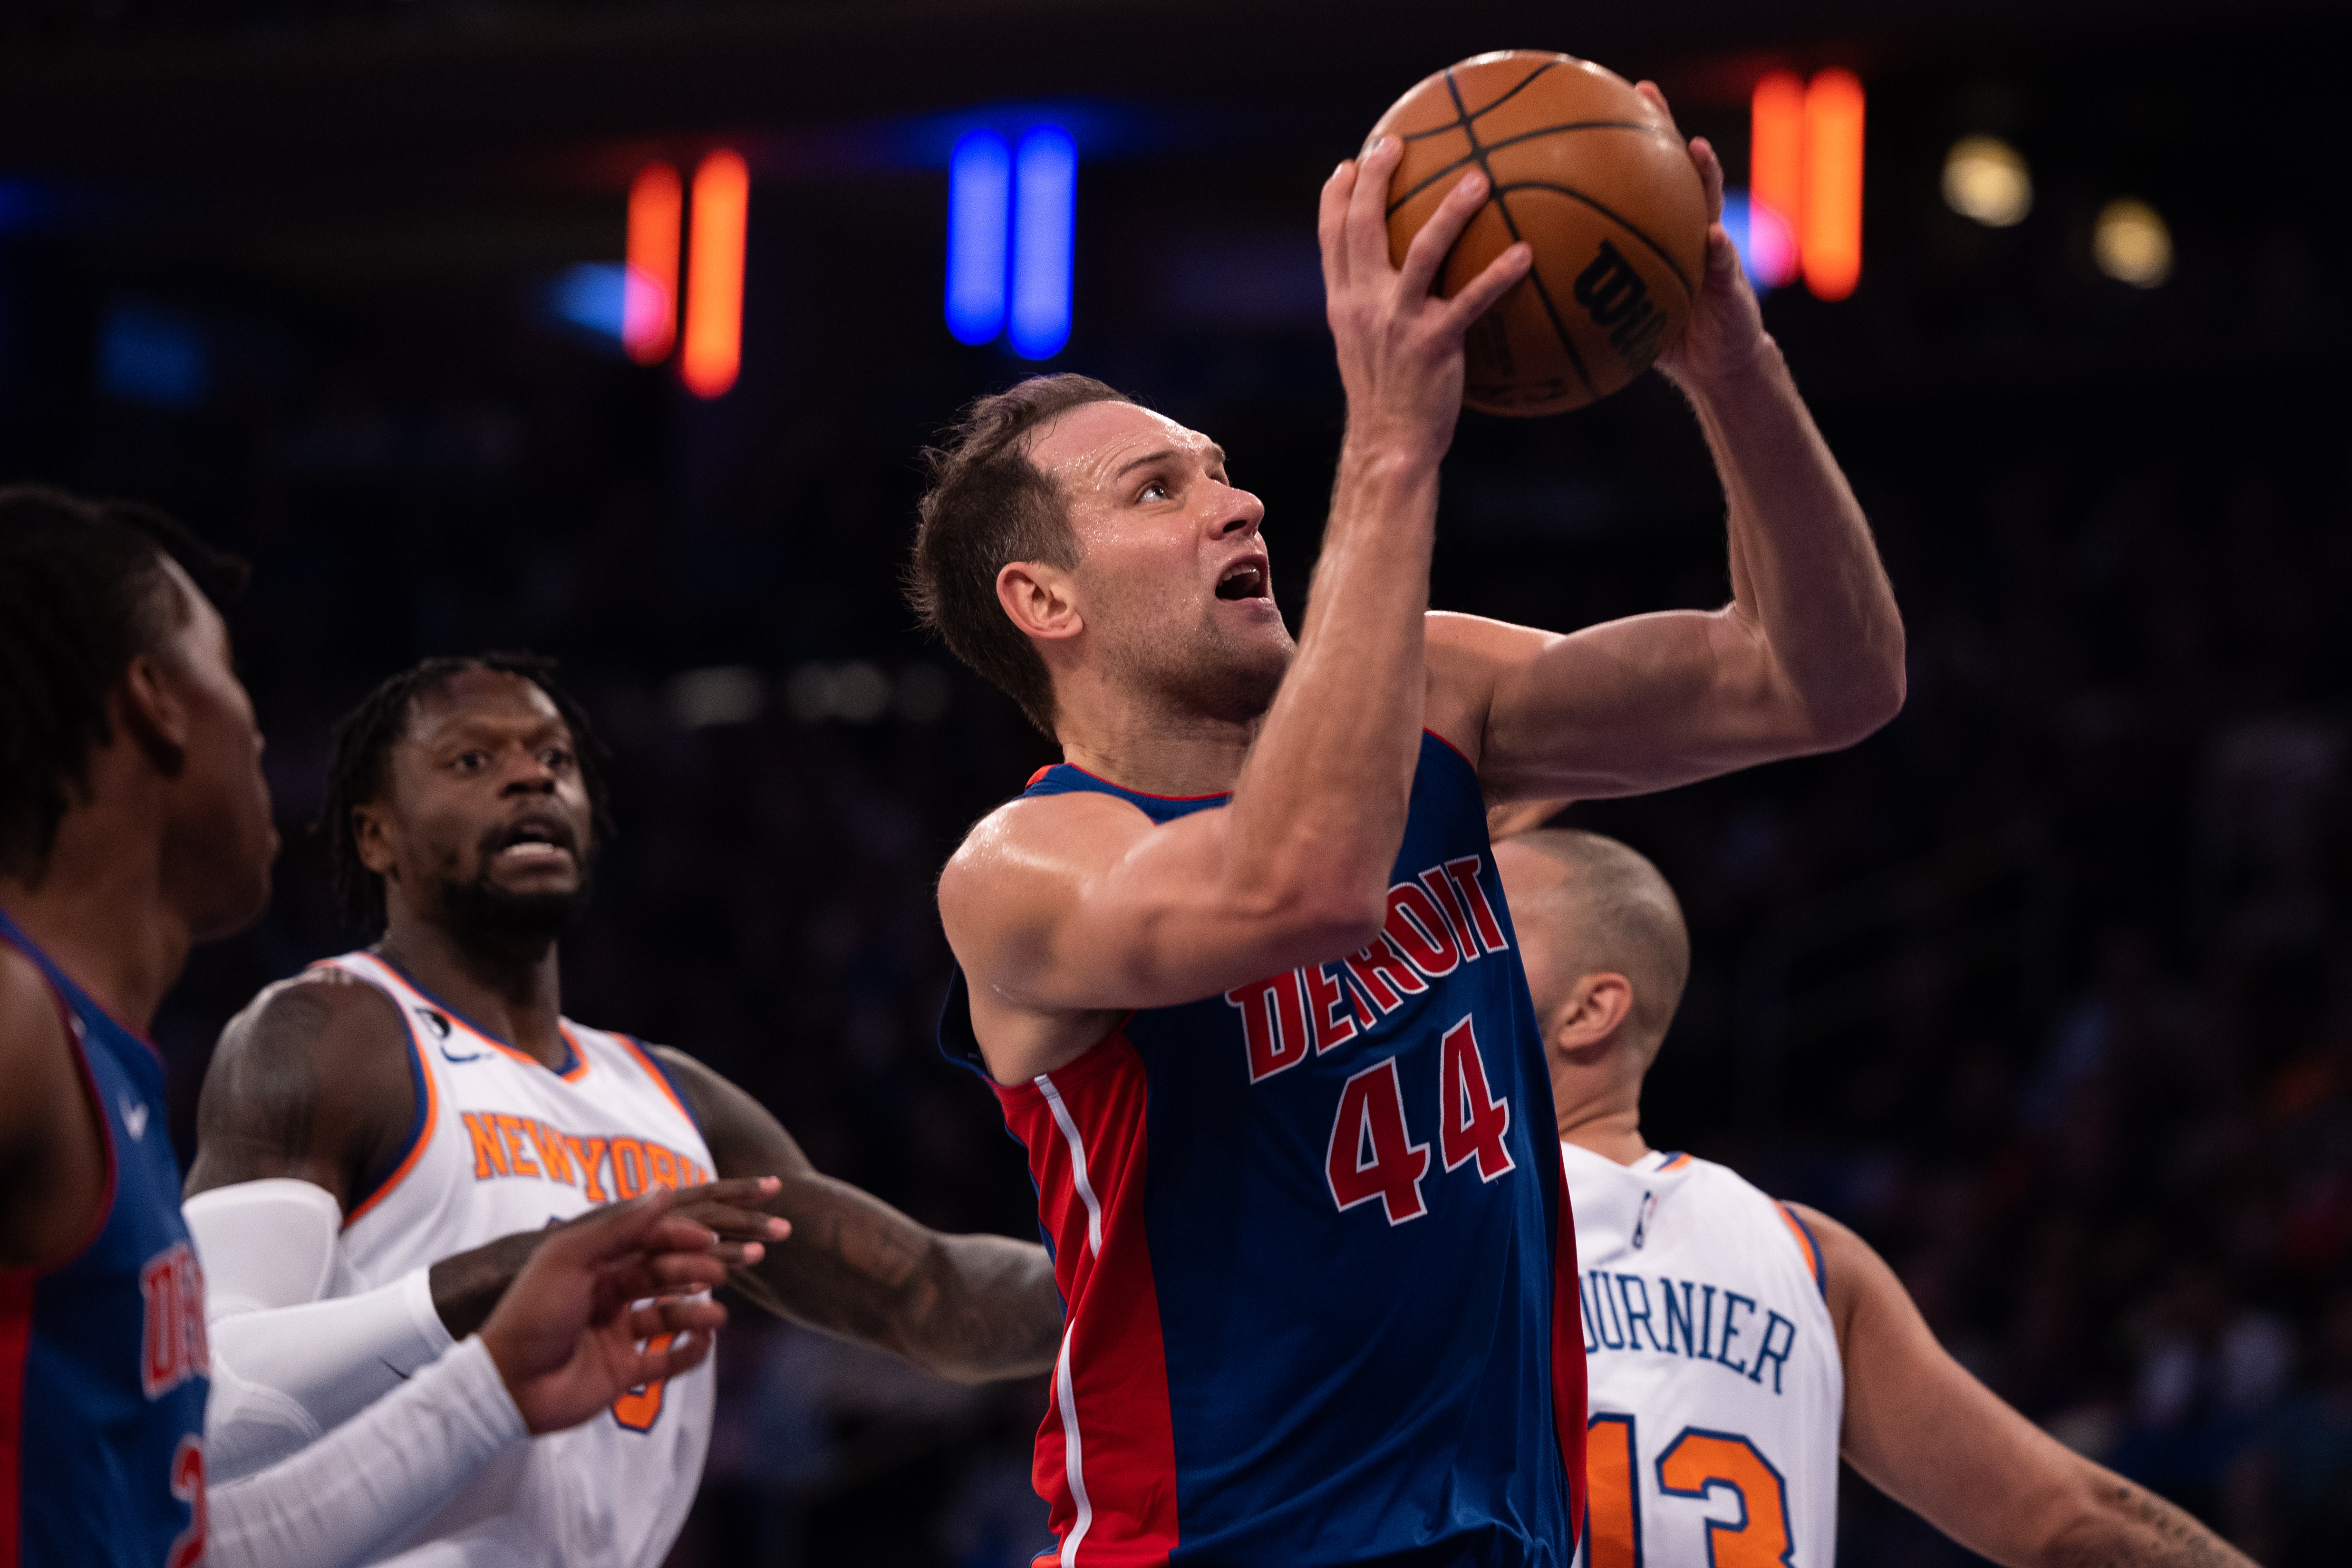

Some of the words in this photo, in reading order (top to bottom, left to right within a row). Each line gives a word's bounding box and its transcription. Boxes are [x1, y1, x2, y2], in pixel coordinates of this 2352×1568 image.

[461, 1111, 575, 1185] NEW
[1326, 1012, 1516, 1226] 44
[1582, 1412, 1795, 1568] 13
